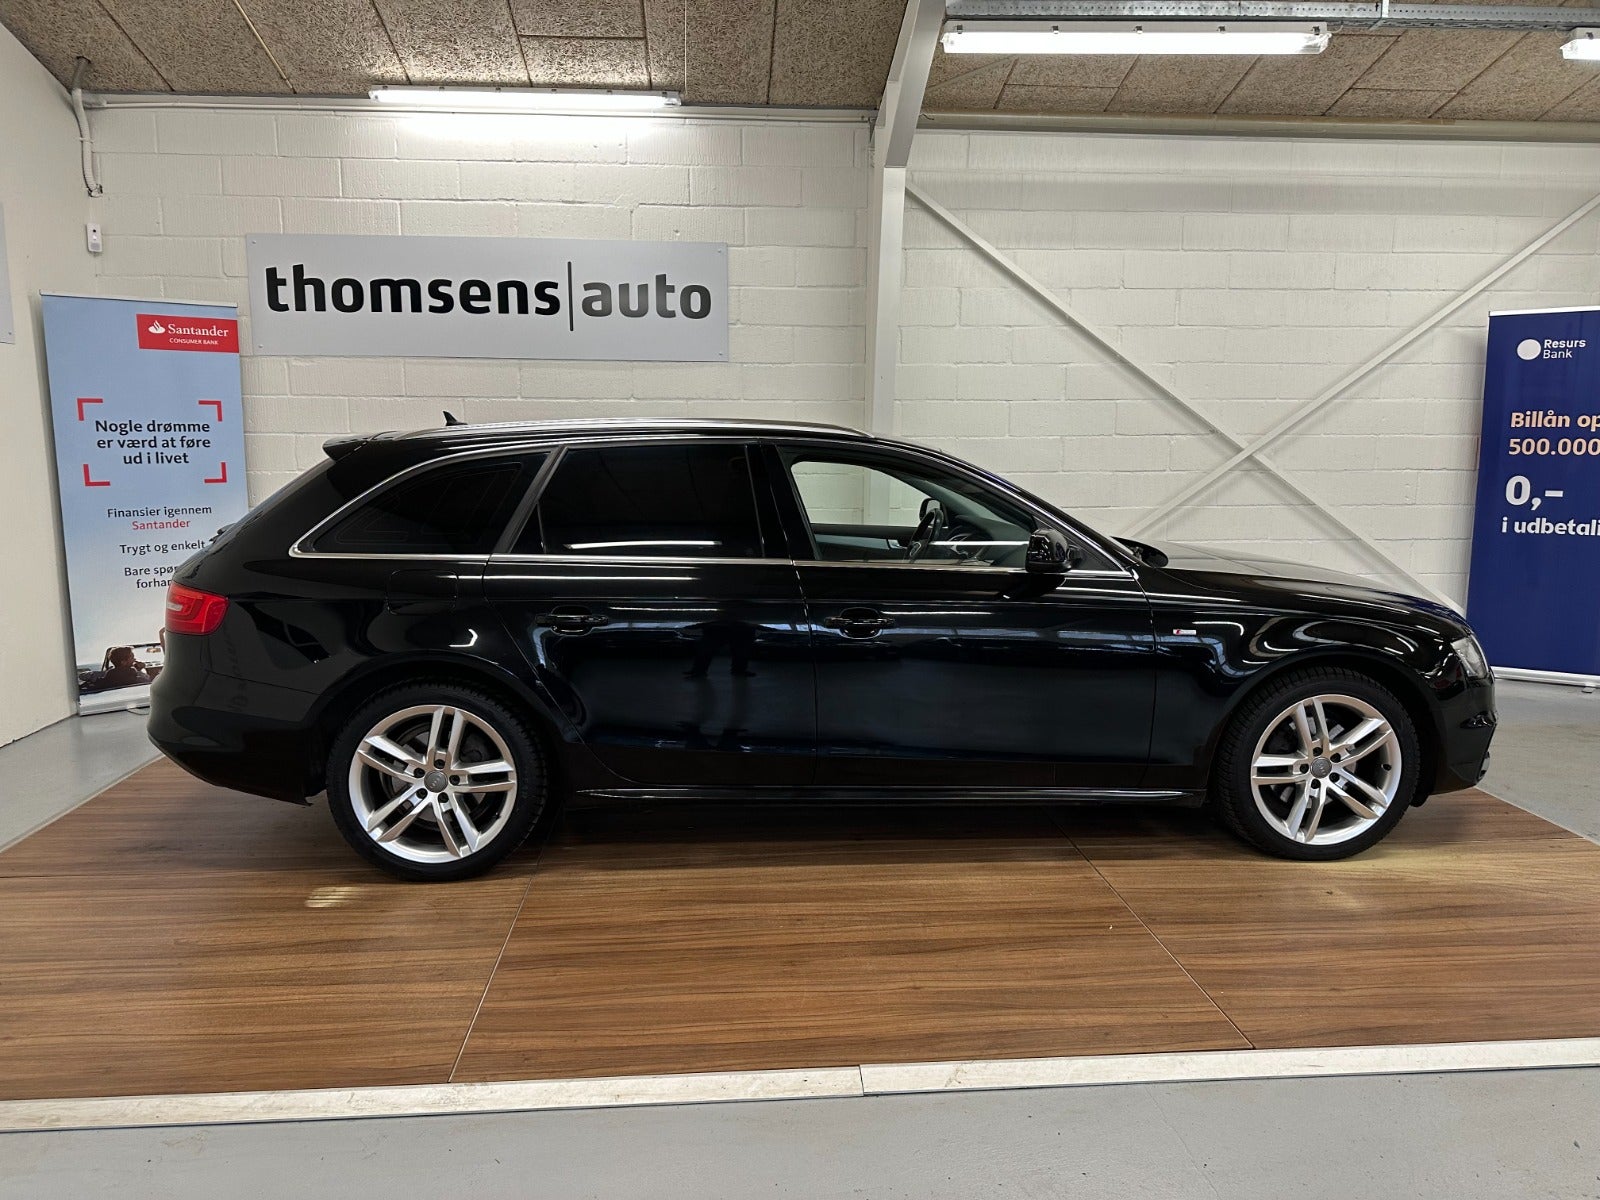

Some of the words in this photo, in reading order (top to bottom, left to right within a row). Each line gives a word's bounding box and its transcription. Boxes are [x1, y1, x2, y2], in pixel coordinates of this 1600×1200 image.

[168, 324, 229, 337] Santander
[1544, 339, 1586, 348] Resurs
[1543, 350, 1572, 359] Bank
[1510, 410, 1570, 428] Billån
[95, 420, 142, 435] Nogle
[147, 421, 210, 432] drømme
[97, 438, 113, 448] er
[118, 436, 157, 448] værd
[162, 438, 176, 448] at
[180, 436, 210, 448] føre
[123, 452, 142, 464] ud
[147, 452, 151, 464] i
[155, 452, 189, 464] livet
[107, 507, 160, 518] Finansier
[164, 506, 212, 516] igennem
[132, 519, 190, 530] Santander
[1501, 517, 1507, 533] i
[120, 544, 151, 555] Trygt
[155, 544, 168, 553] og
[171, 540, 205, 551] enkelt
[125, 567, 150, 576] Bare
